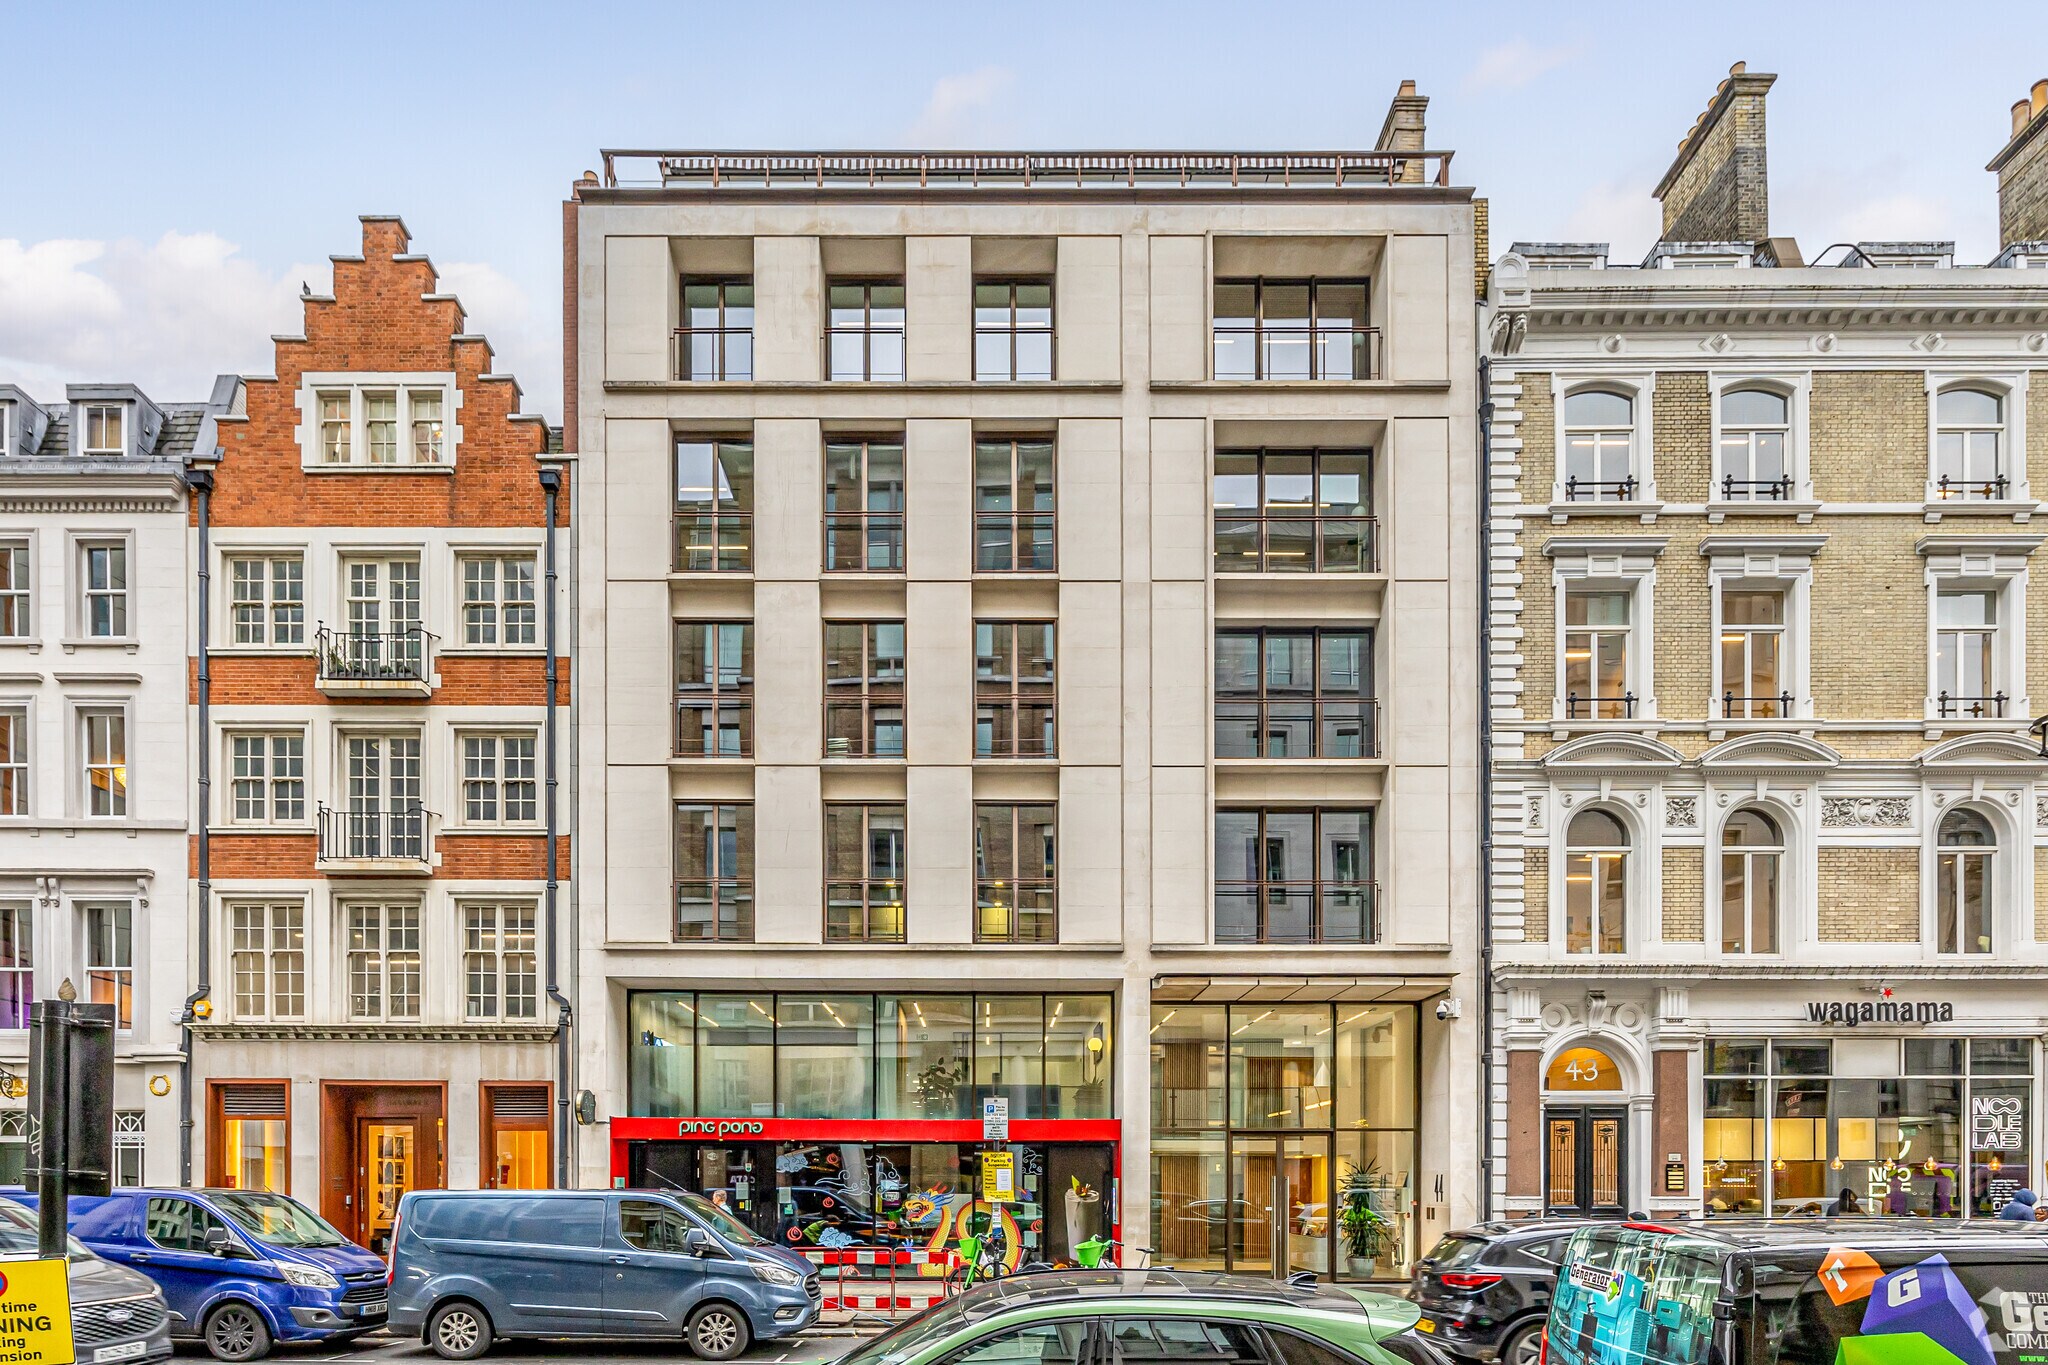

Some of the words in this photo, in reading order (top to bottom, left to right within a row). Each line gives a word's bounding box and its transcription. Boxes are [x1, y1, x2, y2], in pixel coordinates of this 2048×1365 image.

[1807, 1001, 1954, 1027] wagamama
[1565, 1058, 1599, 1082] 43
[679, 1120, 716, 1137] ping
[1972, 1115, 2022, 1132] DLE
[1972, 1132, 2022, 1149] LAB
[1571, 1263, 1611, 1287] Generator
[1825, 1258, 1848, 1293] T
[1887, 1268, 1921, 1308] G
[2028, 1292, 2048, 1304] TH
[1, 1302, 37, 1314] time
